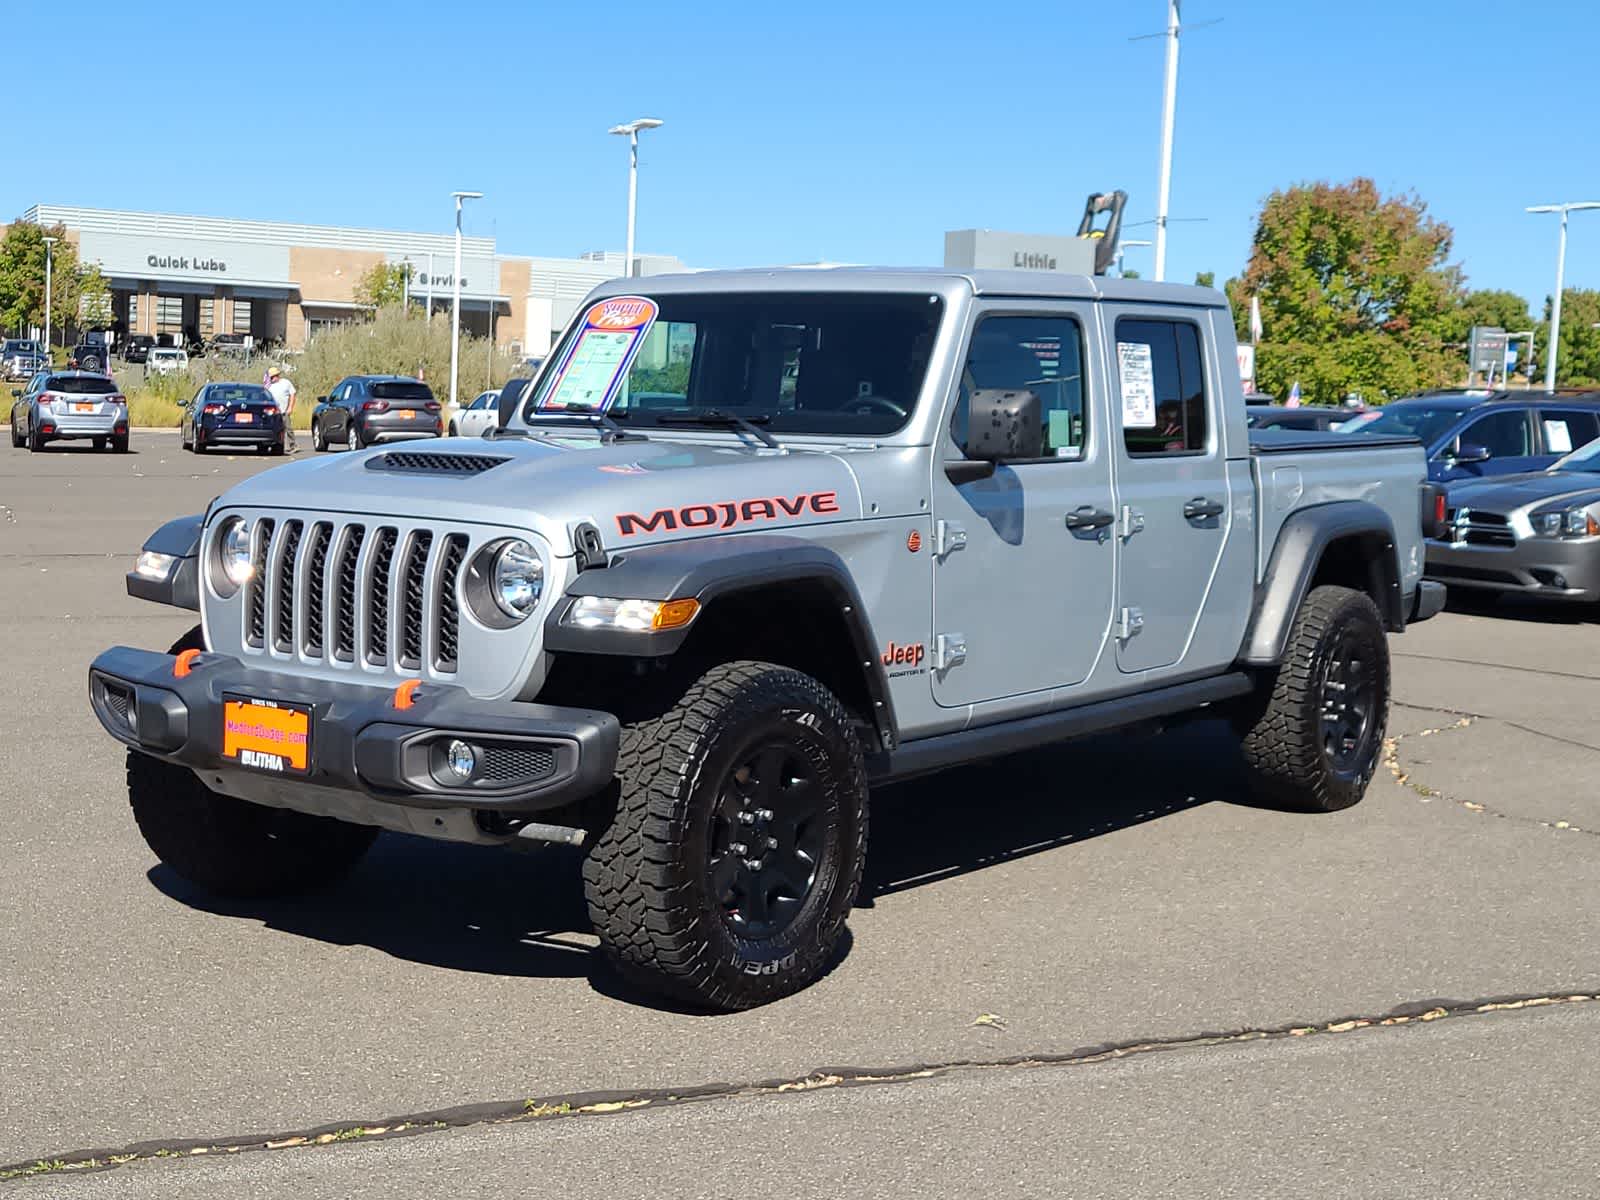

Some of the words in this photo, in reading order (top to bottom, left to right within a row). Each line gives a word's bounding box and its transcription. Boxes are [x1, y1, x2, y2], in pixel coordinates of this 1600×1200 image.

[147, 255, 188, 269] Quick
[193, 257, 226, 271] Lube
[1014, 252, 1056, 270] Lithia
[420, 273, 467, 287] Srvie
[616, 492, 839, 536] MOJAVE
[880, 640, 925, 668] Jeep
[251, 750, 284, 772] LITHIA
